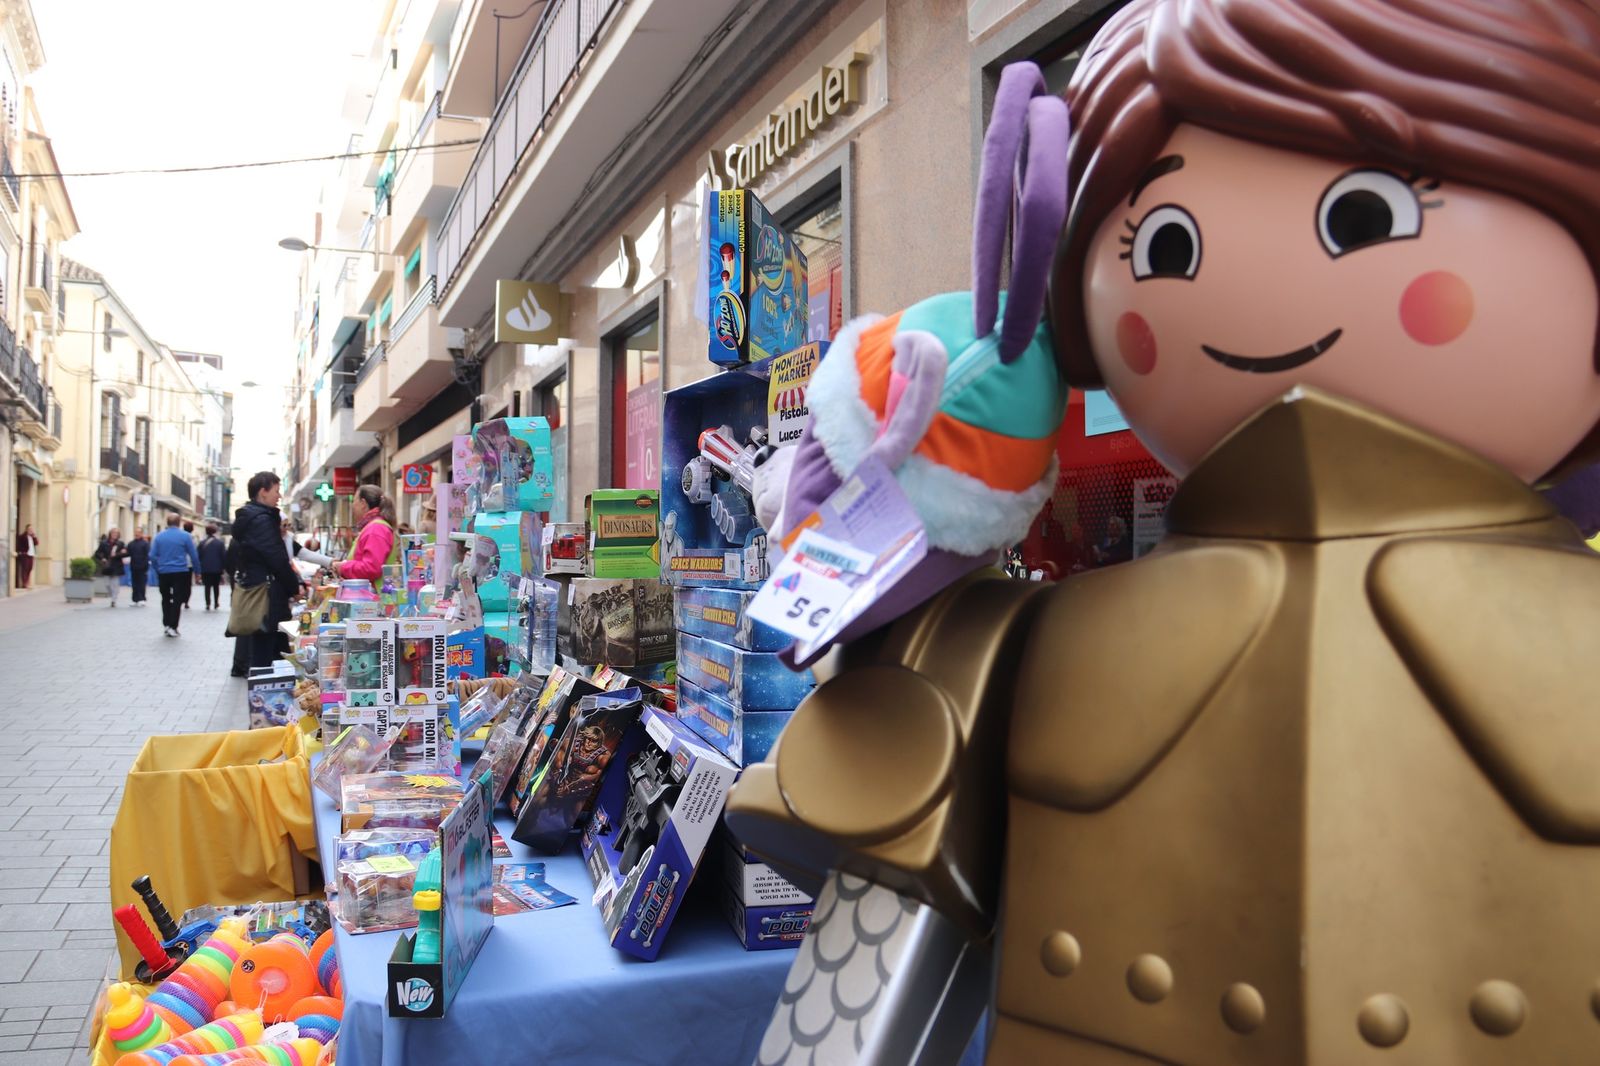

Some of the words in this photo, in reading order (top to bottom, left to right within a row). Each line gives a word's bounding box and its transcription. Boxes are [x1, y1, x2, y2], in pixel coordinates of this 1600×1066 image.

[725, 52, 864, 190] Santander
[775, 347, 816, 374] MONTILLA
[777, 362, 812, 385] MARKET
[780, 404, 809, 421] Pistola
[603, 520, 652, 534] DINOSAURS
[671, 557, 689, 570] SPACE
[689, 557, 723, 571] WARRIORS
[434, 634, 445, 660] IRON
[253, 681, 294, 691] POLICE
[434, 663, 445, 688] MAN
[425, 719, 435, 744] IRON
[697, 794, 713, 823] PROMOTION
[640, 875, 672, 937] POLICE
[768, 919, 810, 934] POLI
[396, 981, 434, 1006] New
